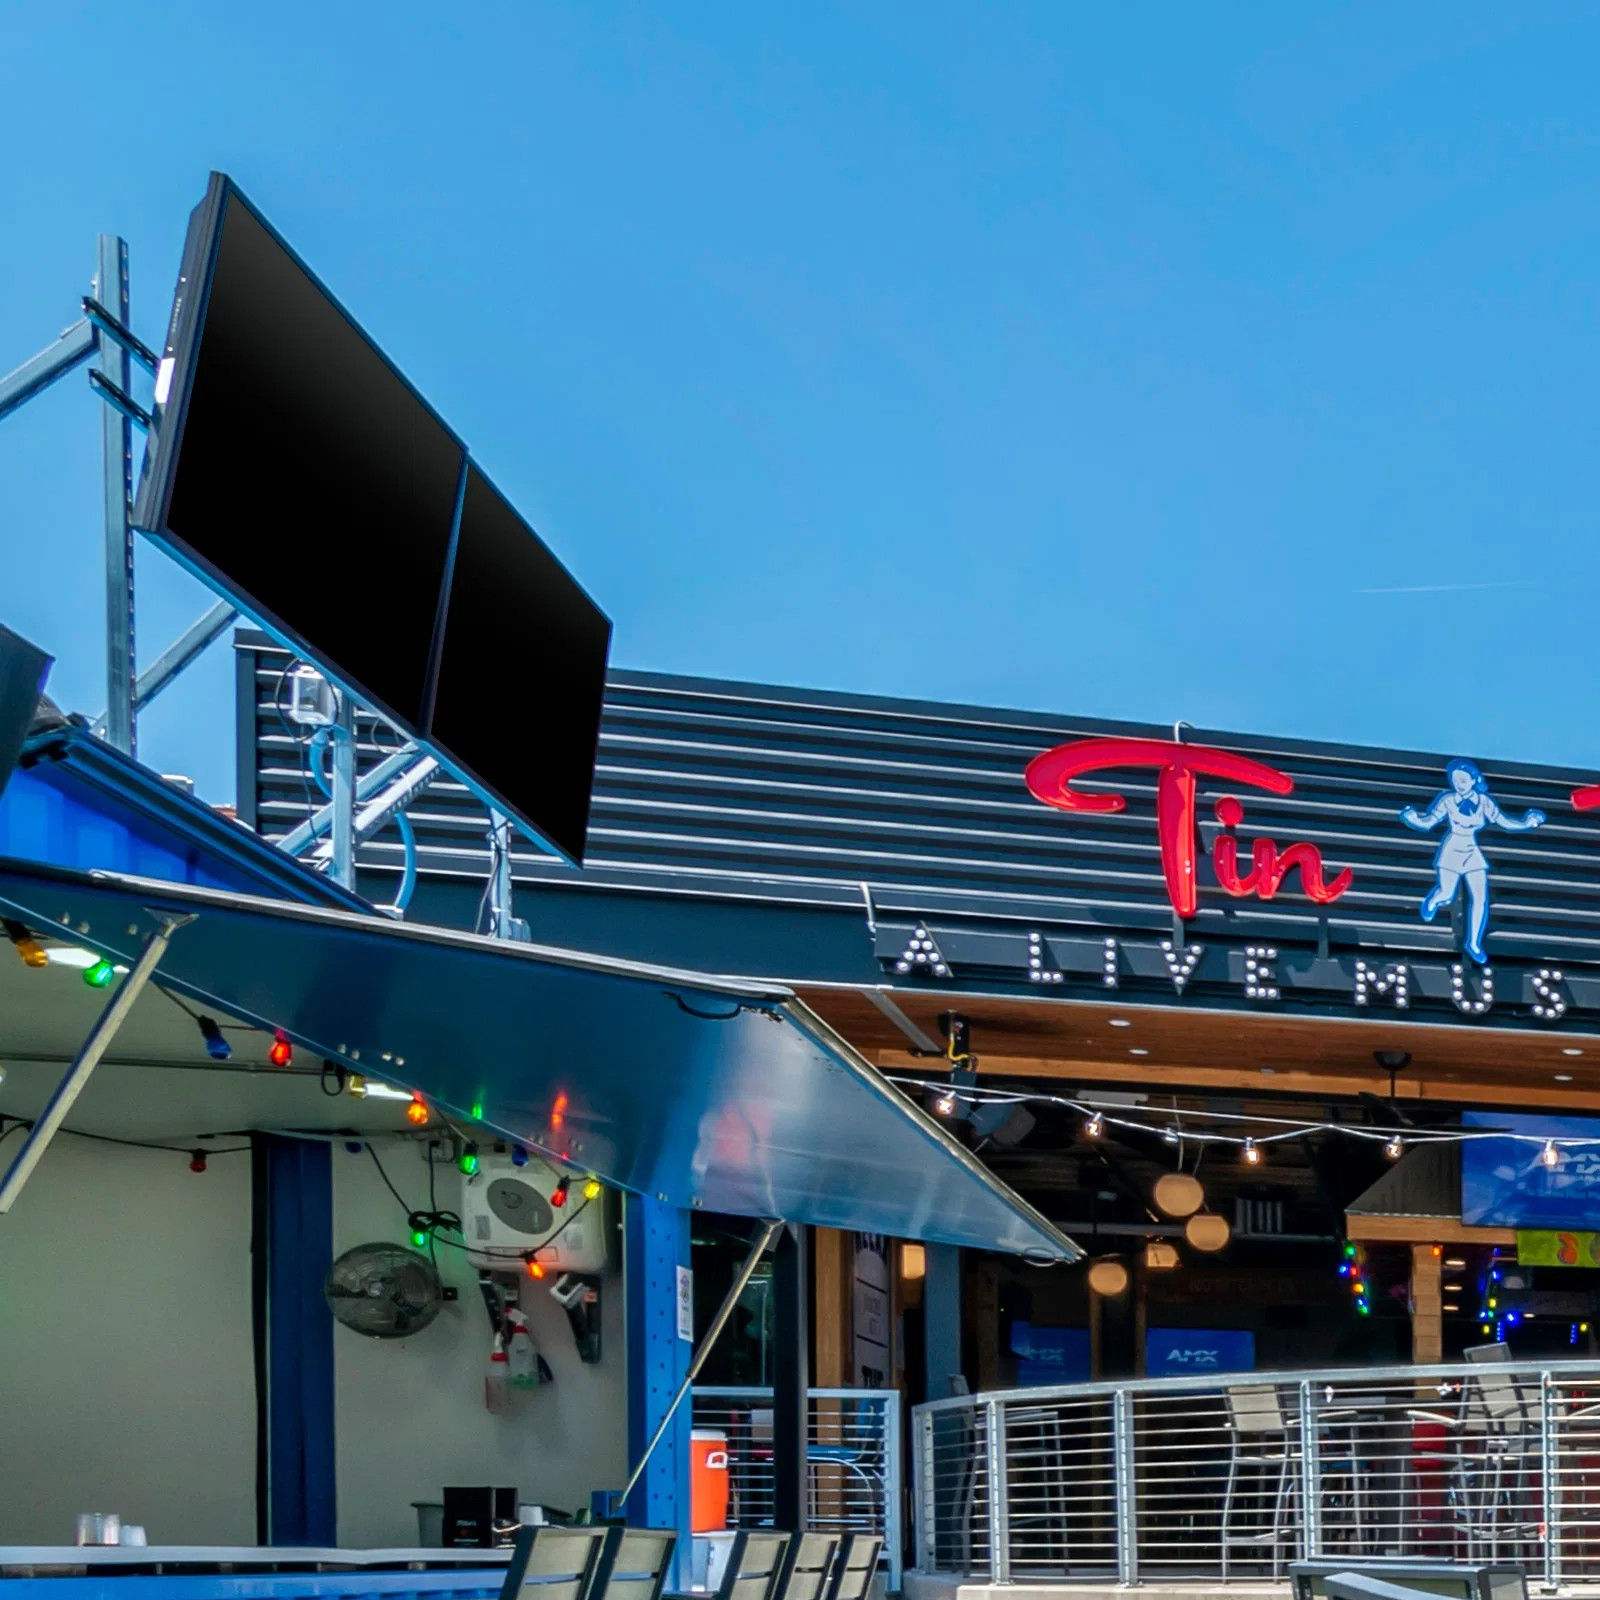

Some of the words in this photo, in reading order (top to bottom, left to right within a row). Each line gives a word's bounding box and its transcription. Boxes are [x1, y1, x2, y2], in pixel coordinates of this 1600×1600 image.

[1024, 738, 1353, 918] Tin
[897, 919, 954, 977] A
[1026, 930, 1281, 999] LIVE
